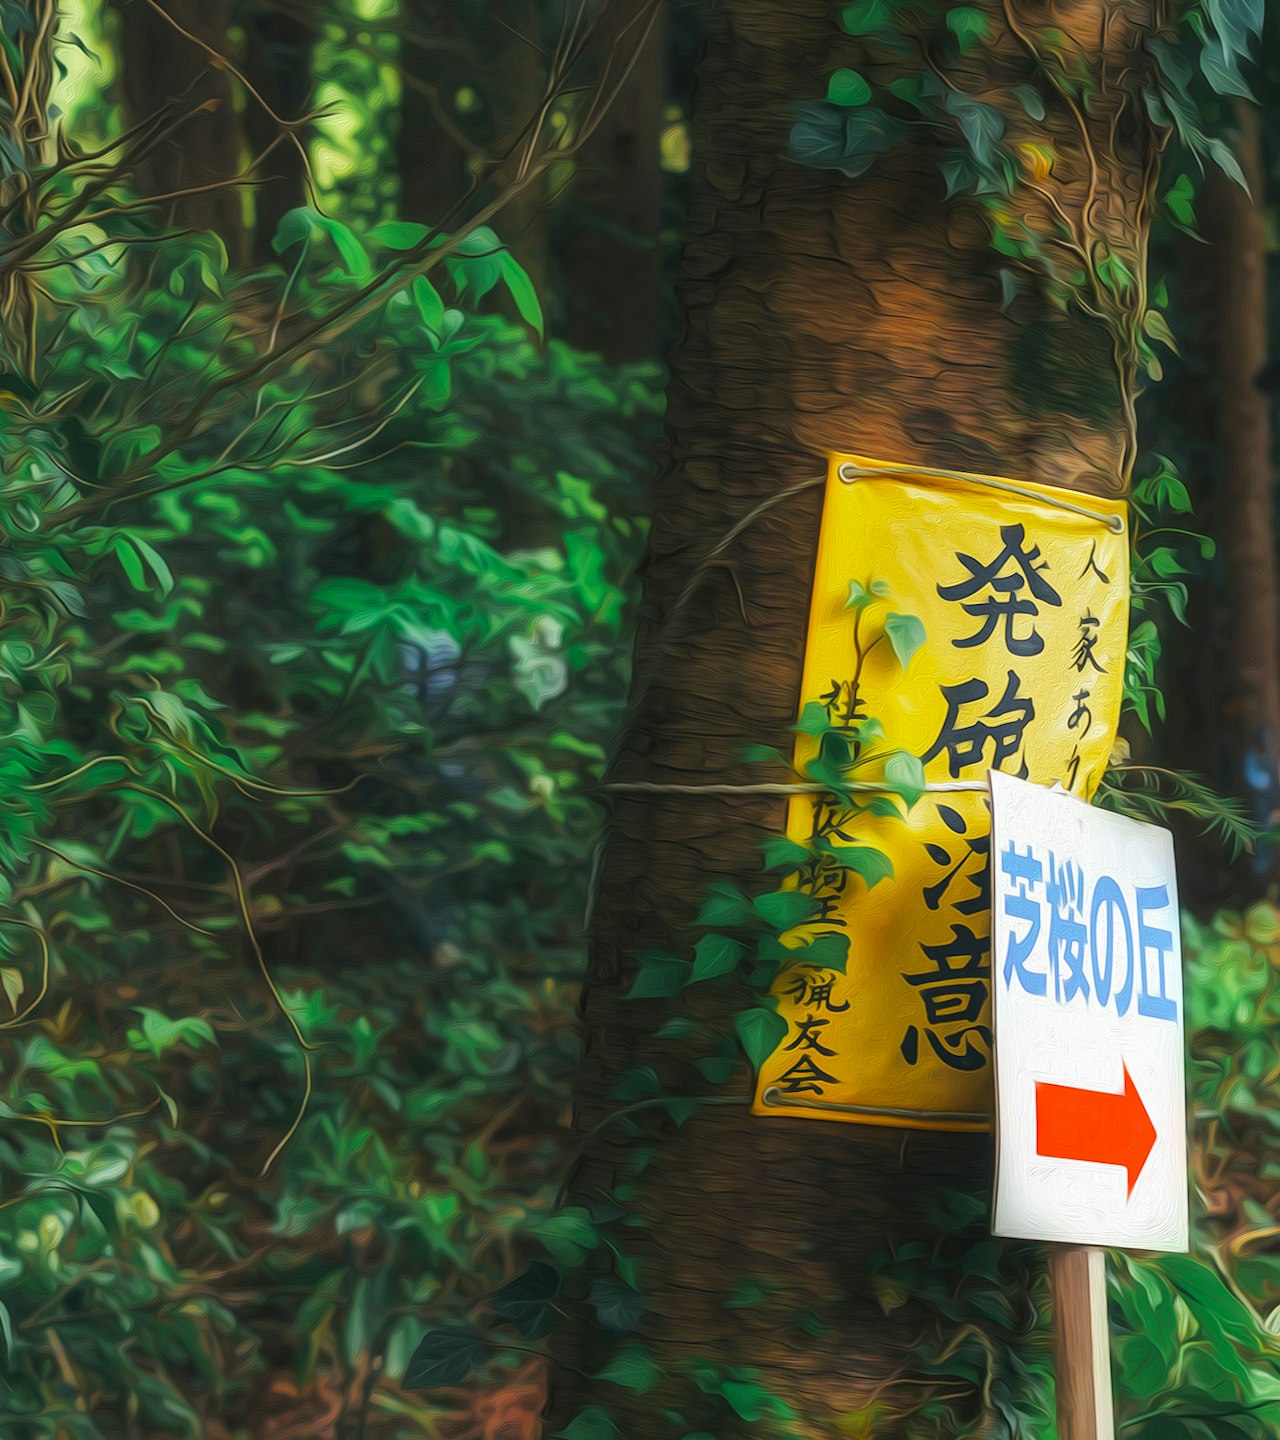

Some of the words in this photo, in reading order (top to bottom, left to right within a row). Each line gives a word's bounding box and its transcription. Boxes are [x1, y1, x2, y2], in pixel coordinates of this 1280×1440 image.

[901, 523, 1063, 1071] 発砲注意
[1001, 839, 1178, 1024] 芝桜の丘
